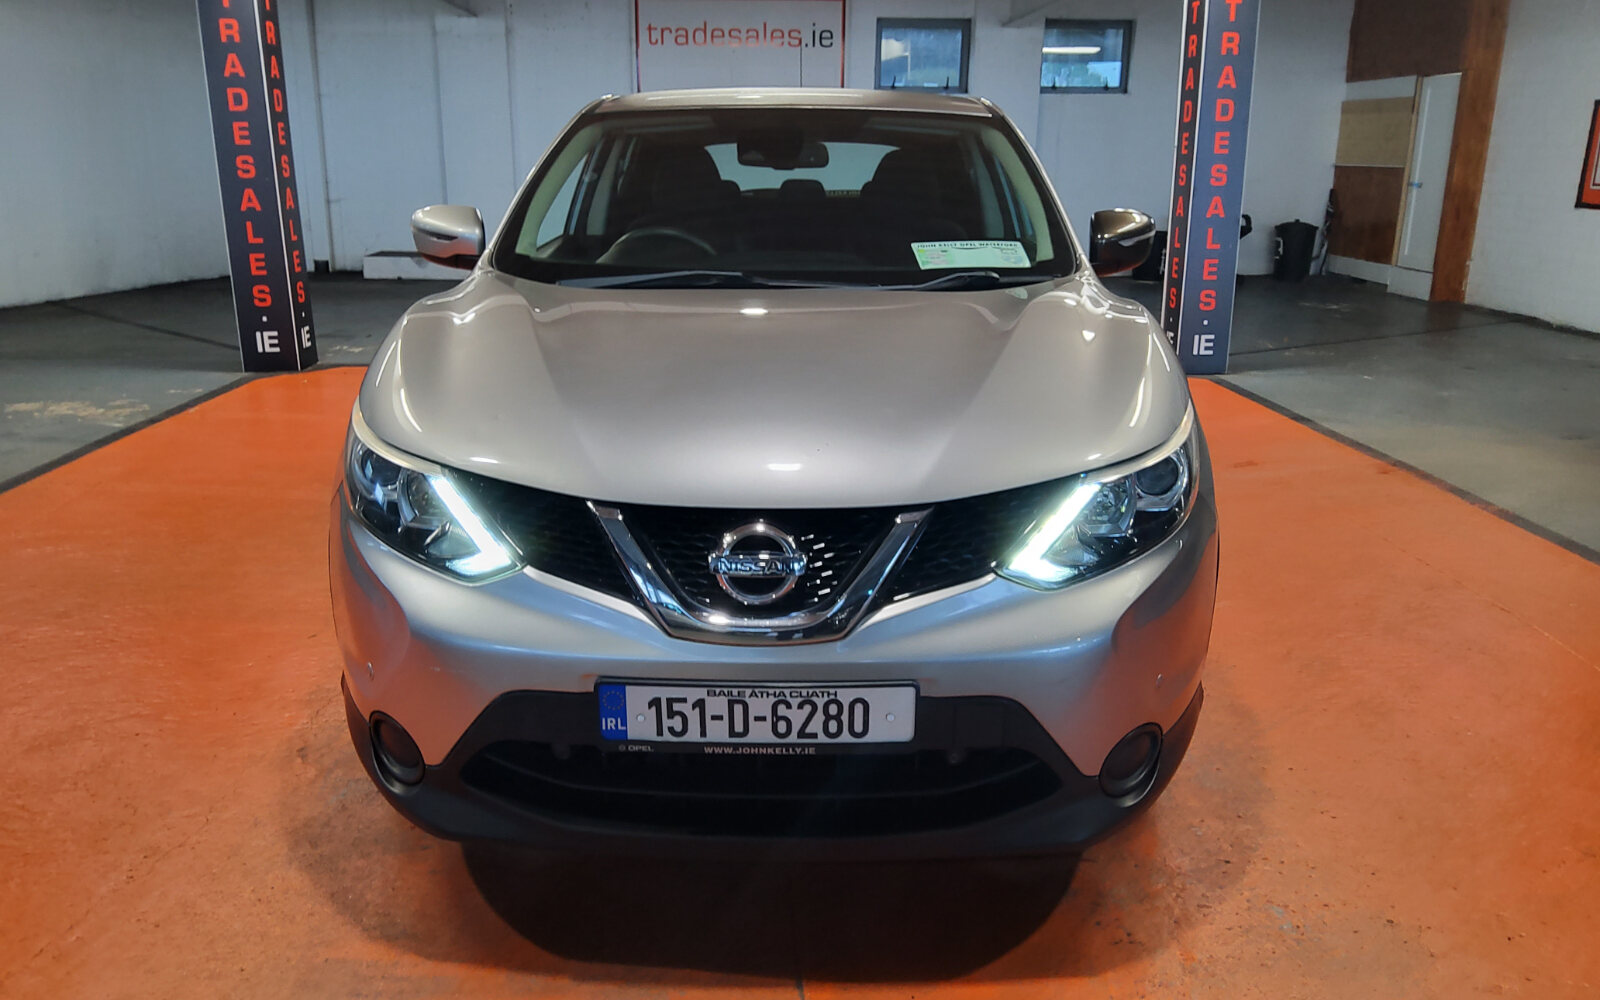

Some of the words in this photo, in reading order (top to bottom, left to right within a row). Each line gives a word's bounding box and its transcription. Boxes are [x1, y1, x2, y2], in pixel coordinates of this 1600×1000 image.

[646, 20, 834, 49] tradesales.ie
[719, 557, 798, 574] NISSAN
[706, 689, 746, 698] BAILE
[601, 716, 627, 730] IRL
[647, 697, 870, 740] 151-D-6280
[704, 745, 816, 755] WWW.JOHNKELLY.IE
